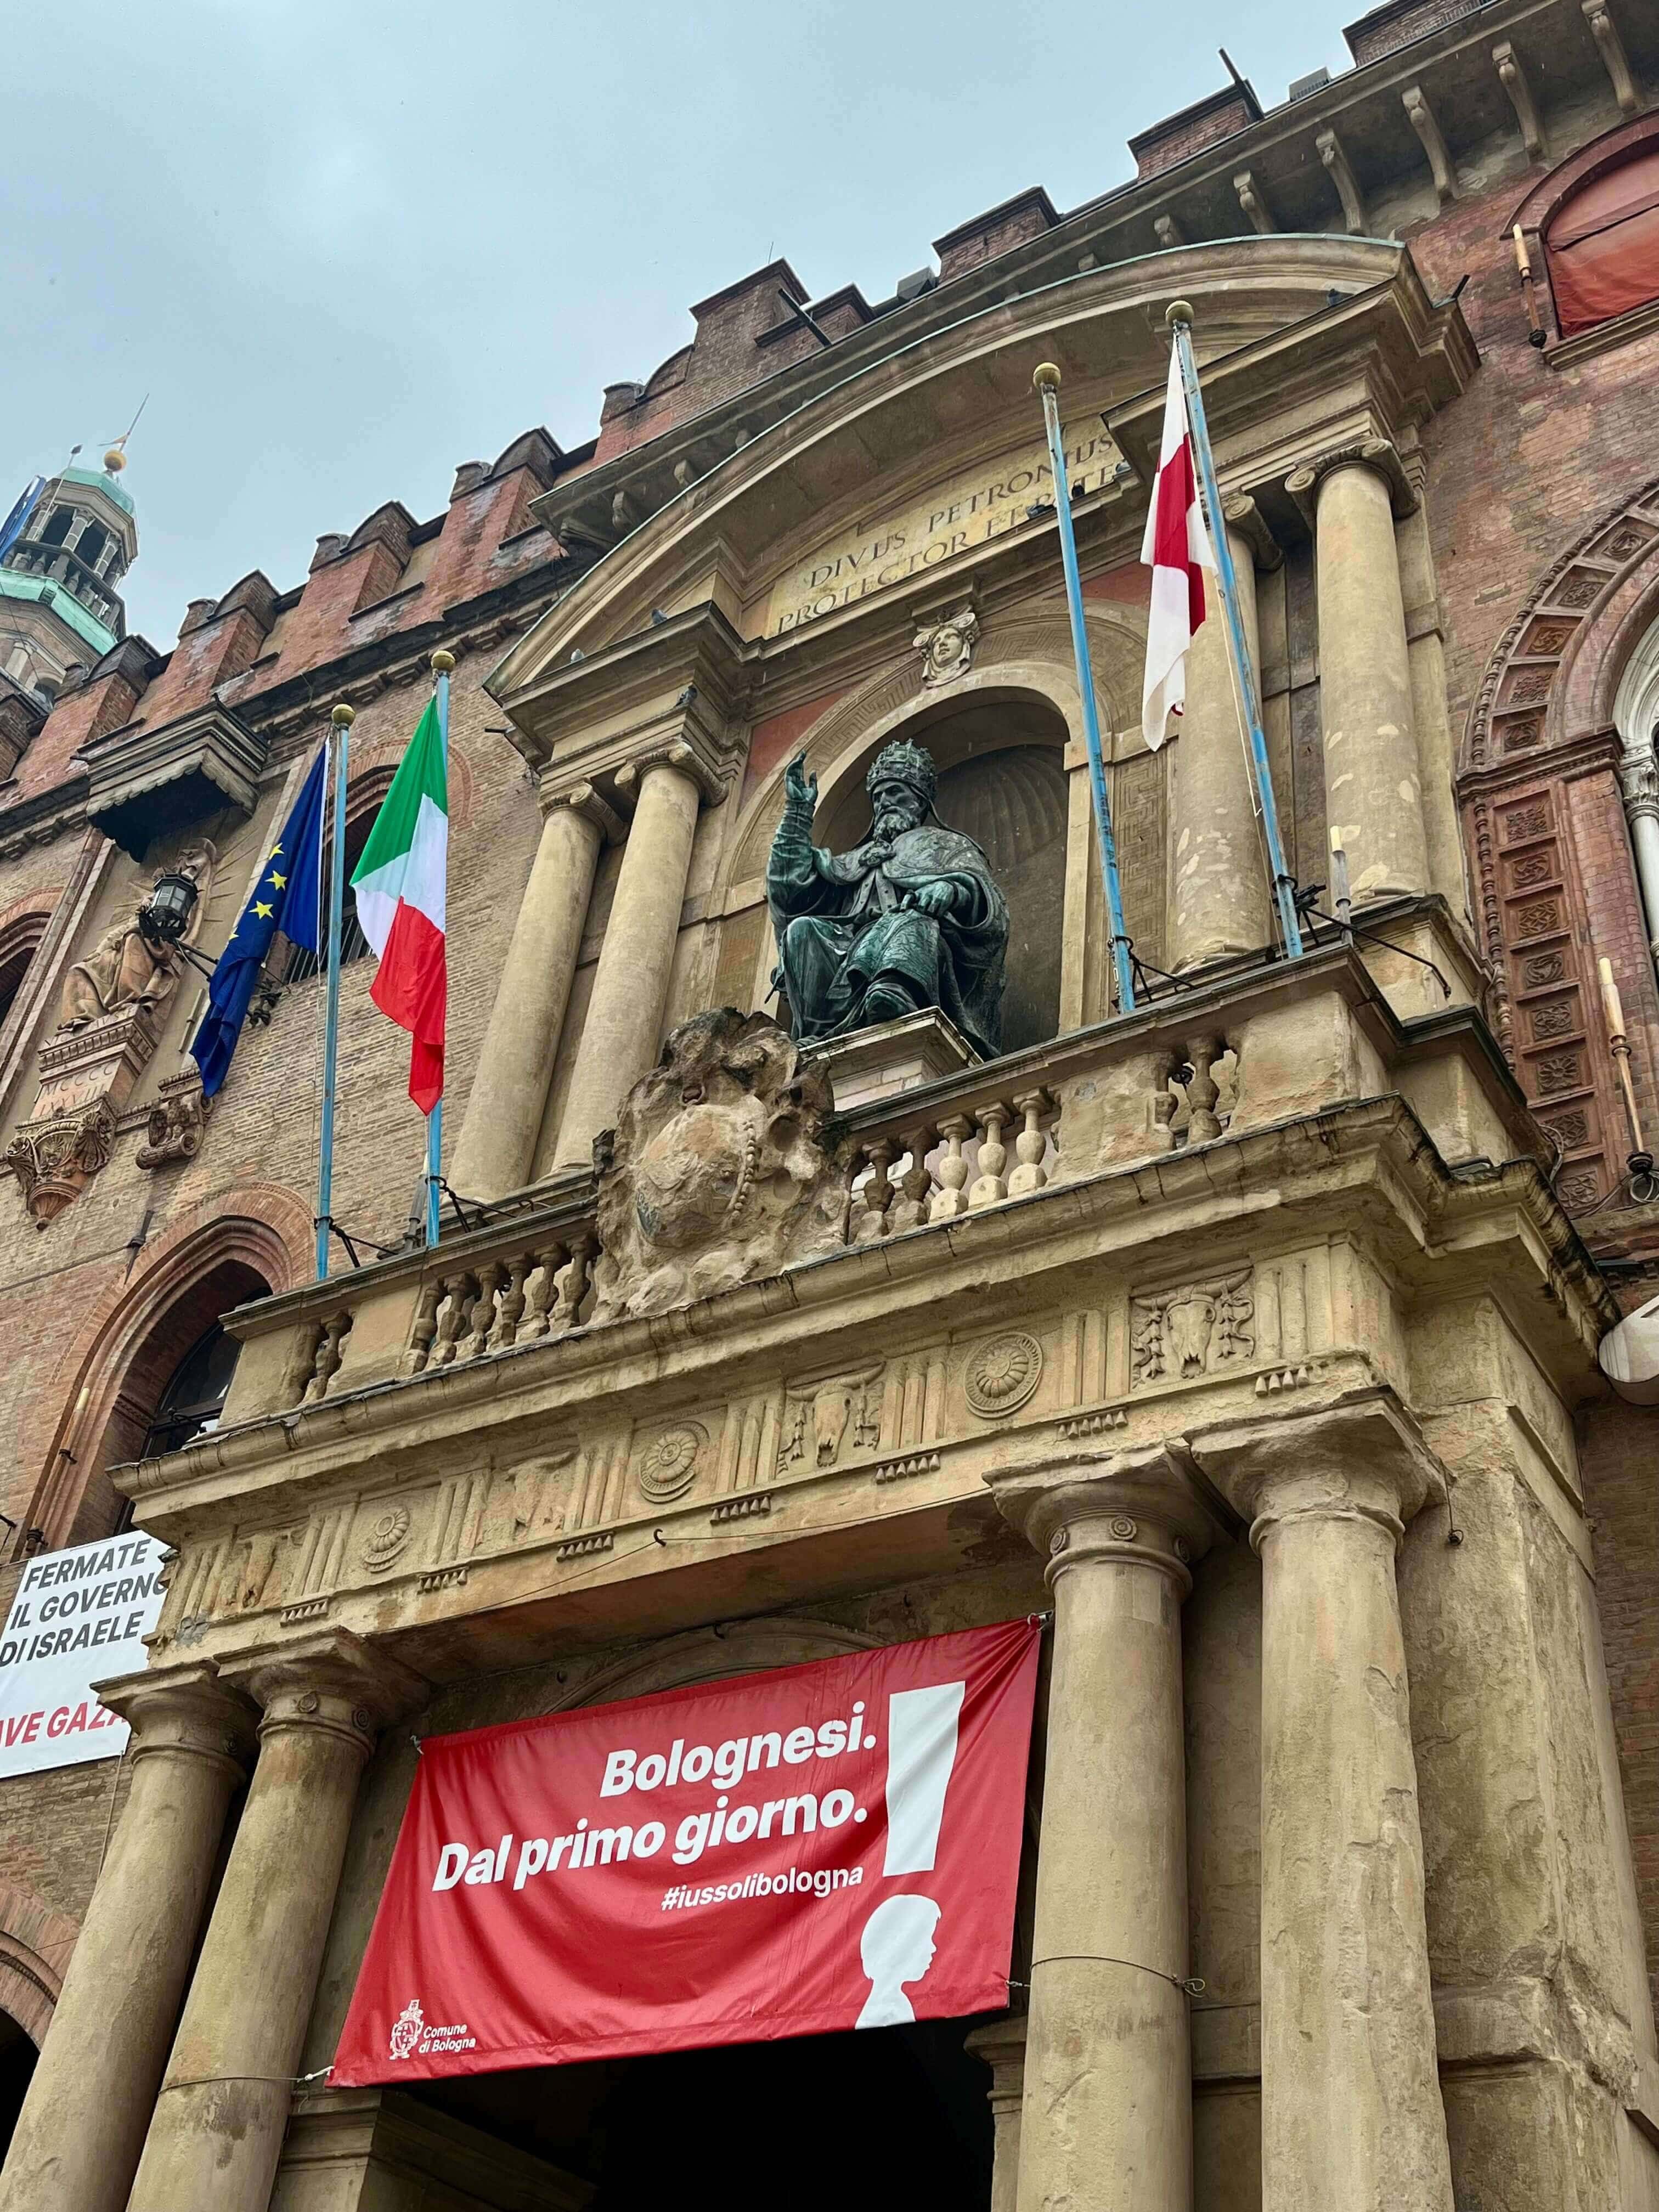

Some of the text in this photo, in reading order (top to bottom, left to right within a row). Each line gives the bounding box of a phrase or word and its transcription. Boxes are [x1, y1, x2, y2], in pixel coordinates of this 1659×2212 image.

[778, 532, 970, 634] PROTECTOR
[987, 504, 1023, 538] ET
[810, 529, 906, 589] DIVUS
[24, 1538, 151, 1593] FERMATE
[0, 1610, 144, 1667] DI ISRAELE
[10, 1602, 31, 1630] IL
[600, 1701, 876, 1798] Bolognesi.
[432, 1790, 867, 1892] Dal primo giorno.
[661, 1867, 864, 1911] #iussolibologna
[419, 2038, 476, 2053] di Bologna
[424, 2024, 467, 2039] Comune
